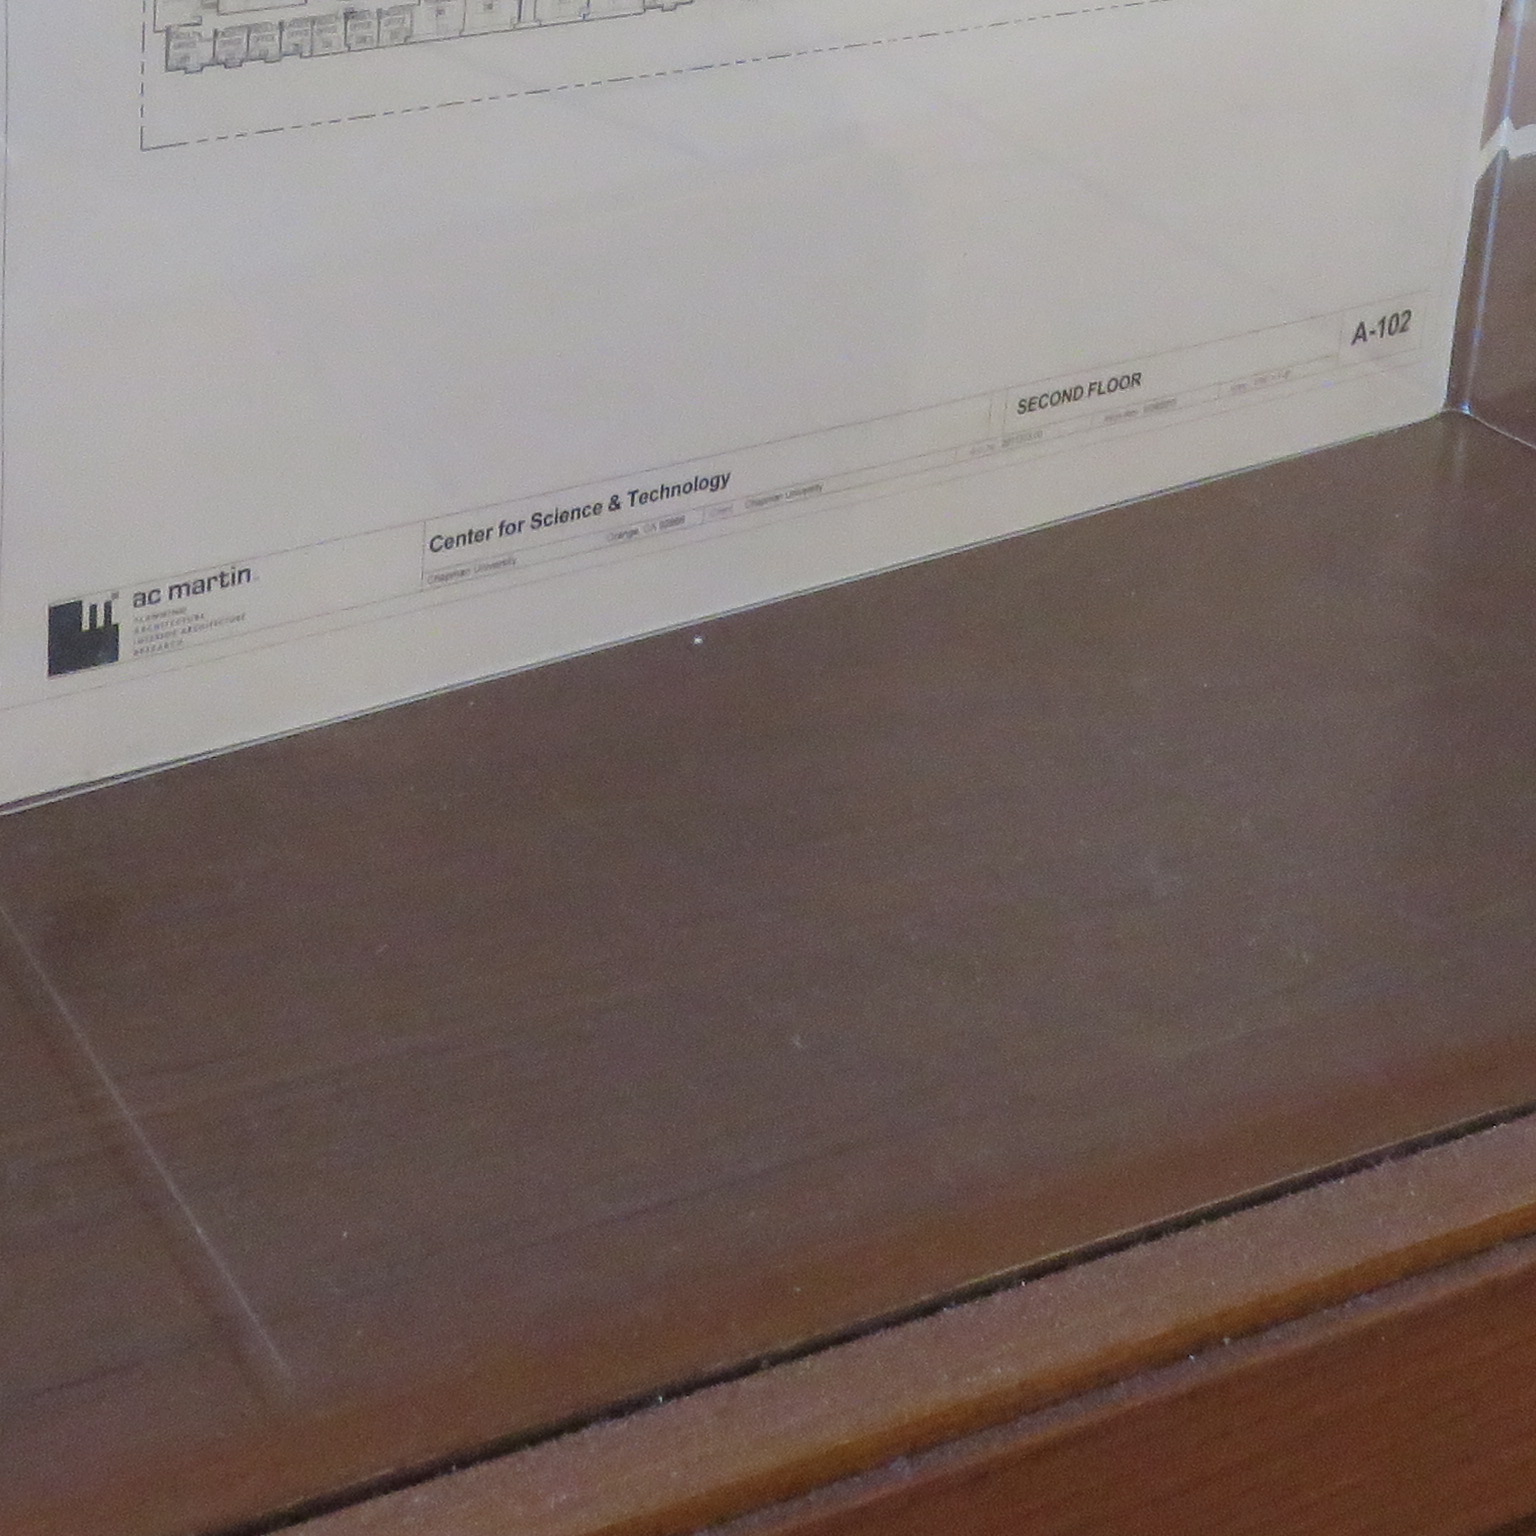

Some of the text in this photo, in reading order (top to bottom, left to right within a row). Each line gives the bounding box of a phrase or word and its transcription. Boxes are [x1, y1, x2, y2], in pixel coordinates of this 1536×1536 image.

[1350, 308, 1412, 346] A-102
[1016, 385, 1084, 415] SECOND
[1086, 371, 1142, 399] FLOOR
[428, 525, 494, 553] Center
[497, 518, 526, 538] for
[530, 500, 603, 531] Science
[608, 494, 622, 512] &
[627, 471, 732, 508] Technology
[132, 566, 252, 609] ac martin
